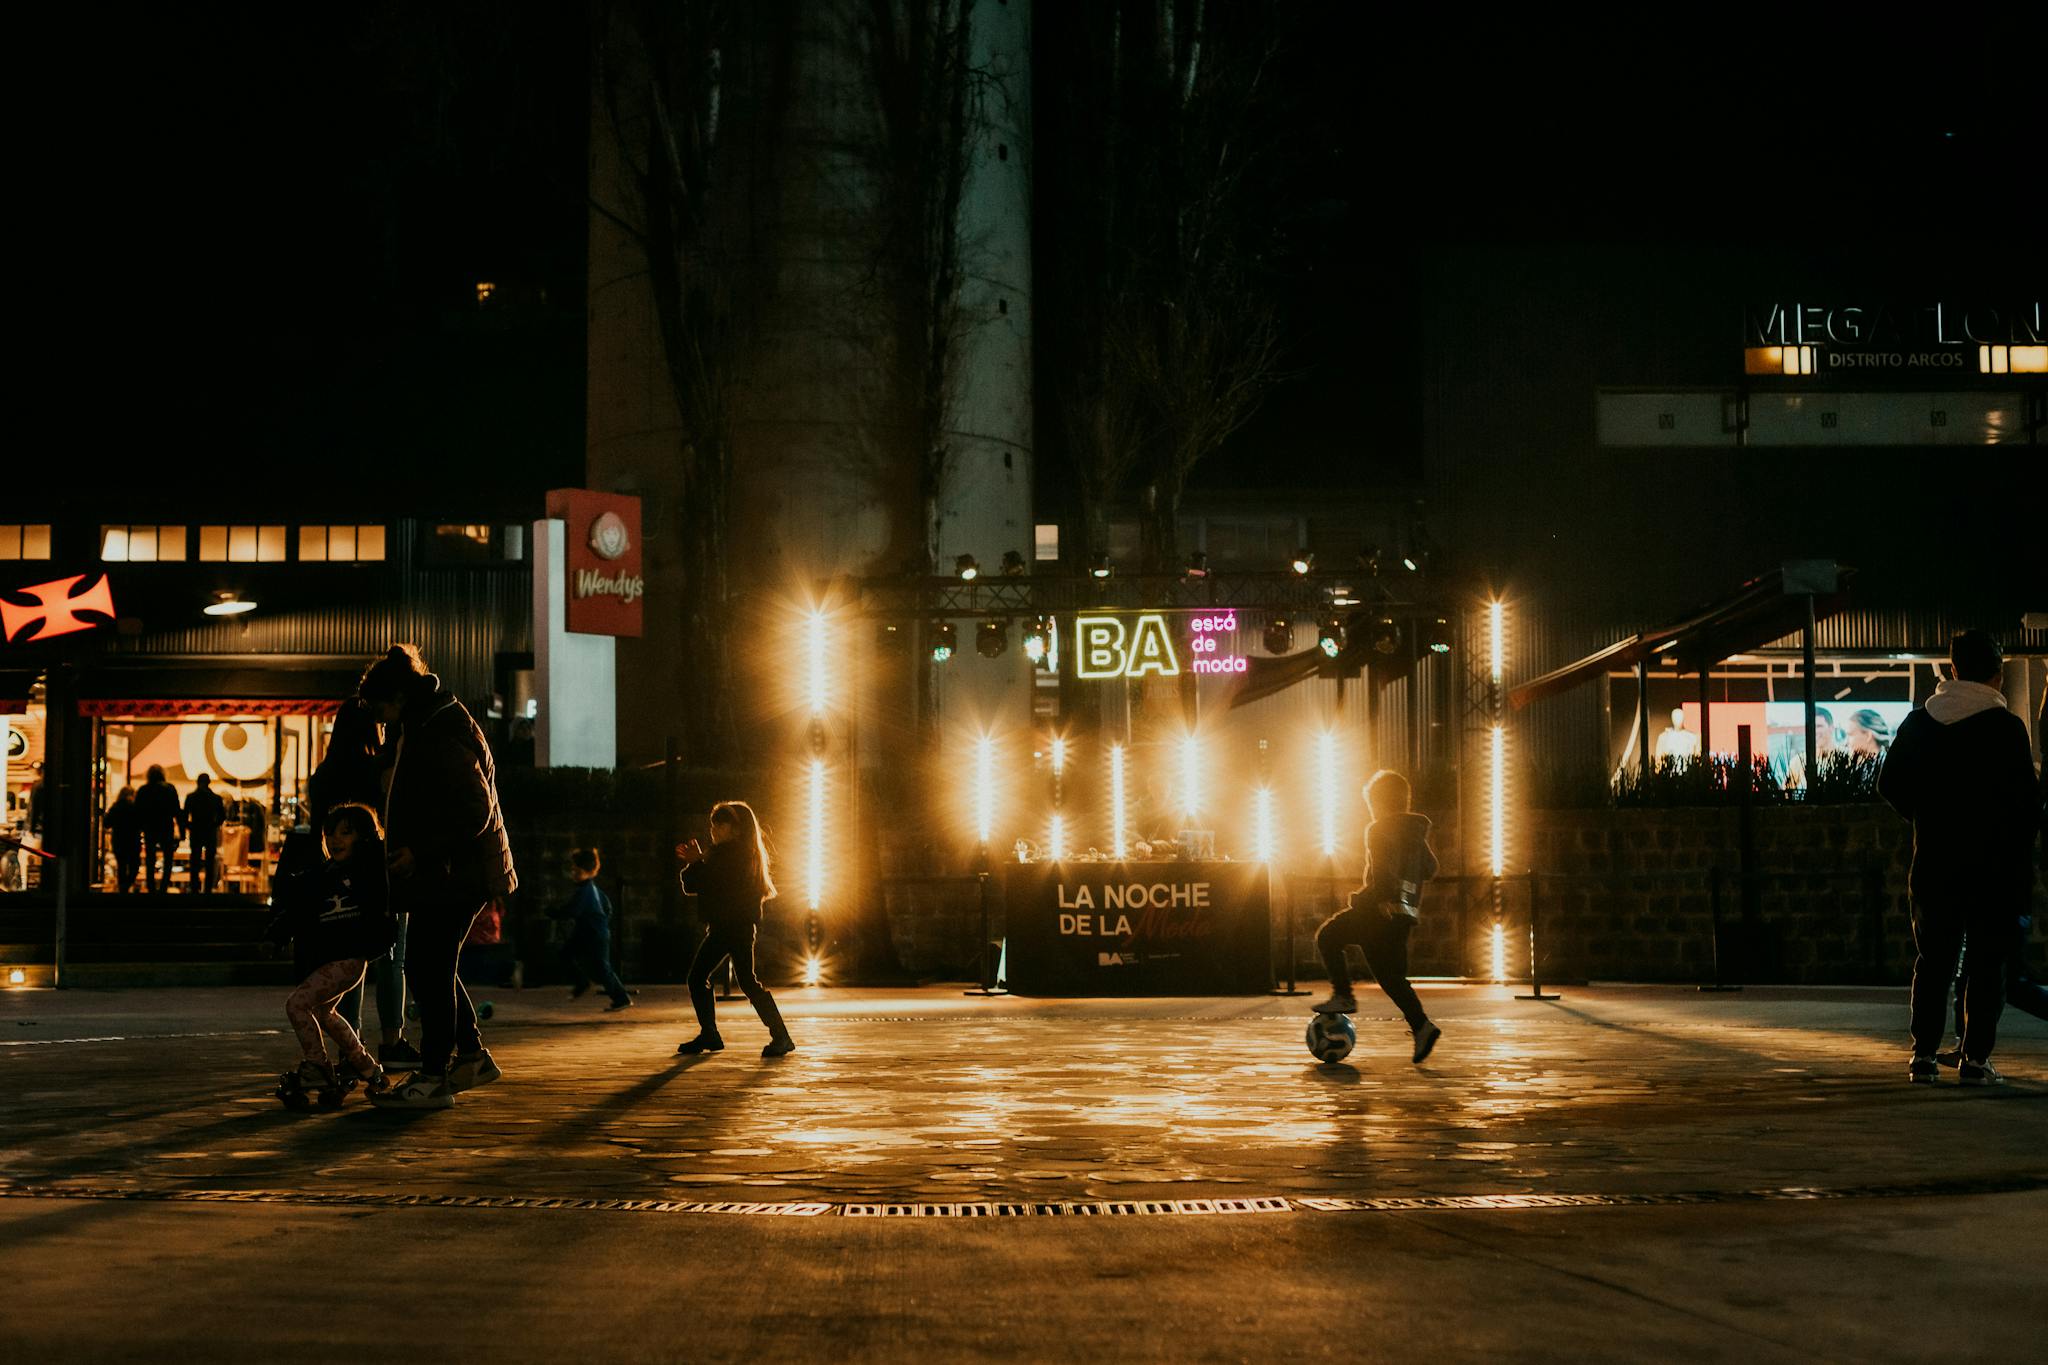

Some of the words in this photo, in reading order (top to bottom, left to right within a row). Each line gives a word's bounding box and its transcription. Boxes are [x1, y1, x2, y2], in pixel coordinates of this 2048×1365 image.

[1745, 303, 2048, 344] MEGALON
[1829, 353, 1902, 367] DISTRITO
[1907, 352, 1963, 367] ARCOS
[578, 568, 644, 603] Wendy's
[1191, 610, 1236, 631] está
[1076, 615, 1180, 678] BA
[1191, 636, 1216, 652] de
[1193, 655, 1247, 673] moda
[1058, 884, 1095, 909] LA
[1104, 883, 1211, 909] NOCHE
[1059, 914, 1092, 935] DE
[1100, 914, 1132, 936] LA
[1098, 952, 1124, 966] BA
